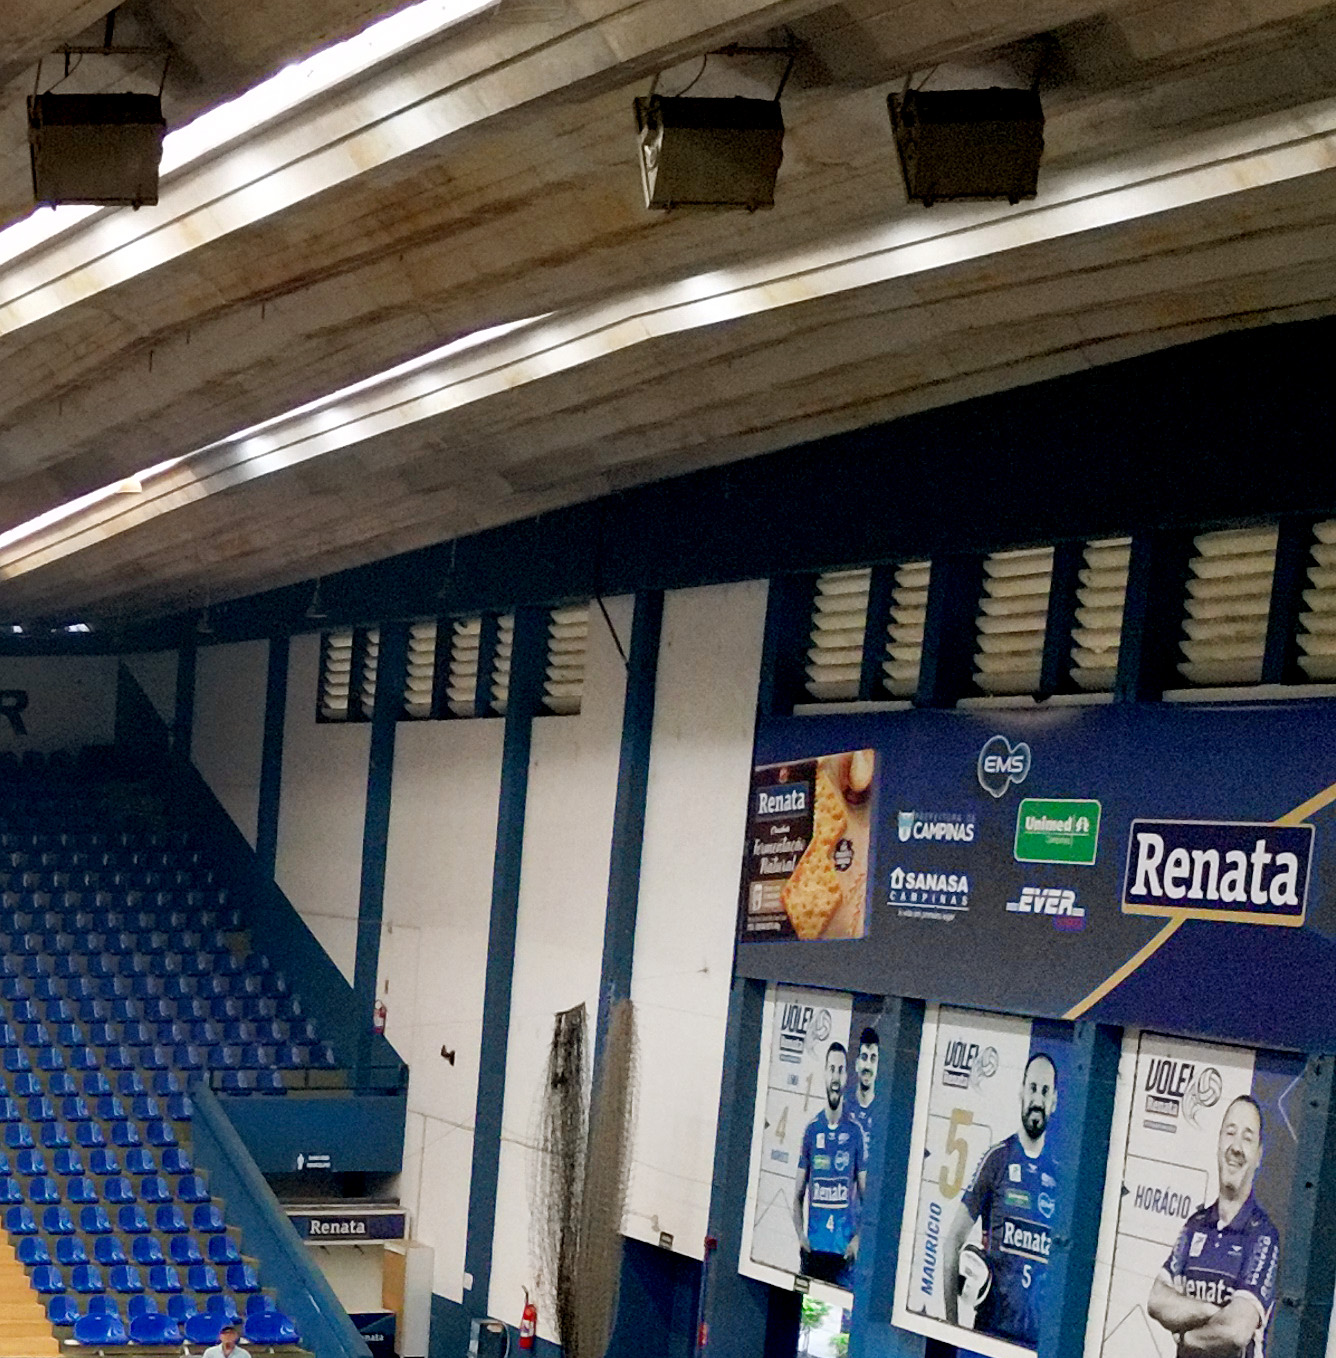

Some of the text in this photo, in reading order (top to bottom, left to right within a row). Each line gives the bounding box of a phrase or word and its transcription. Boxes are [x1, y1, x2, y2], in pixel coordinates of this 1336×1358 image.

[984, 754, 1024, 774] EMS
[758, 789, 805, 814] Renata
[913, 821, 974, 842] CAMPINAS
[1025, 815, 1073, 832] Unimed
[1130, 832, 1299, 906] Renata
[905, 872, 969, 894] SANASA
[889, 891, 969, 906] CAMPINAS
[1018, 887, 1076, 915] EVER
[775, 1105, 790, 1145] 4
[938, 1107, 974, 1200] 5
[1134, 1184, 1193, 1220] HORÁCIO
[309, 1220, 366, 1235] Renata
[921, 1202, 942, 1296] MAURÍCIO
[1021, 1264, 1032, 1289] 5
